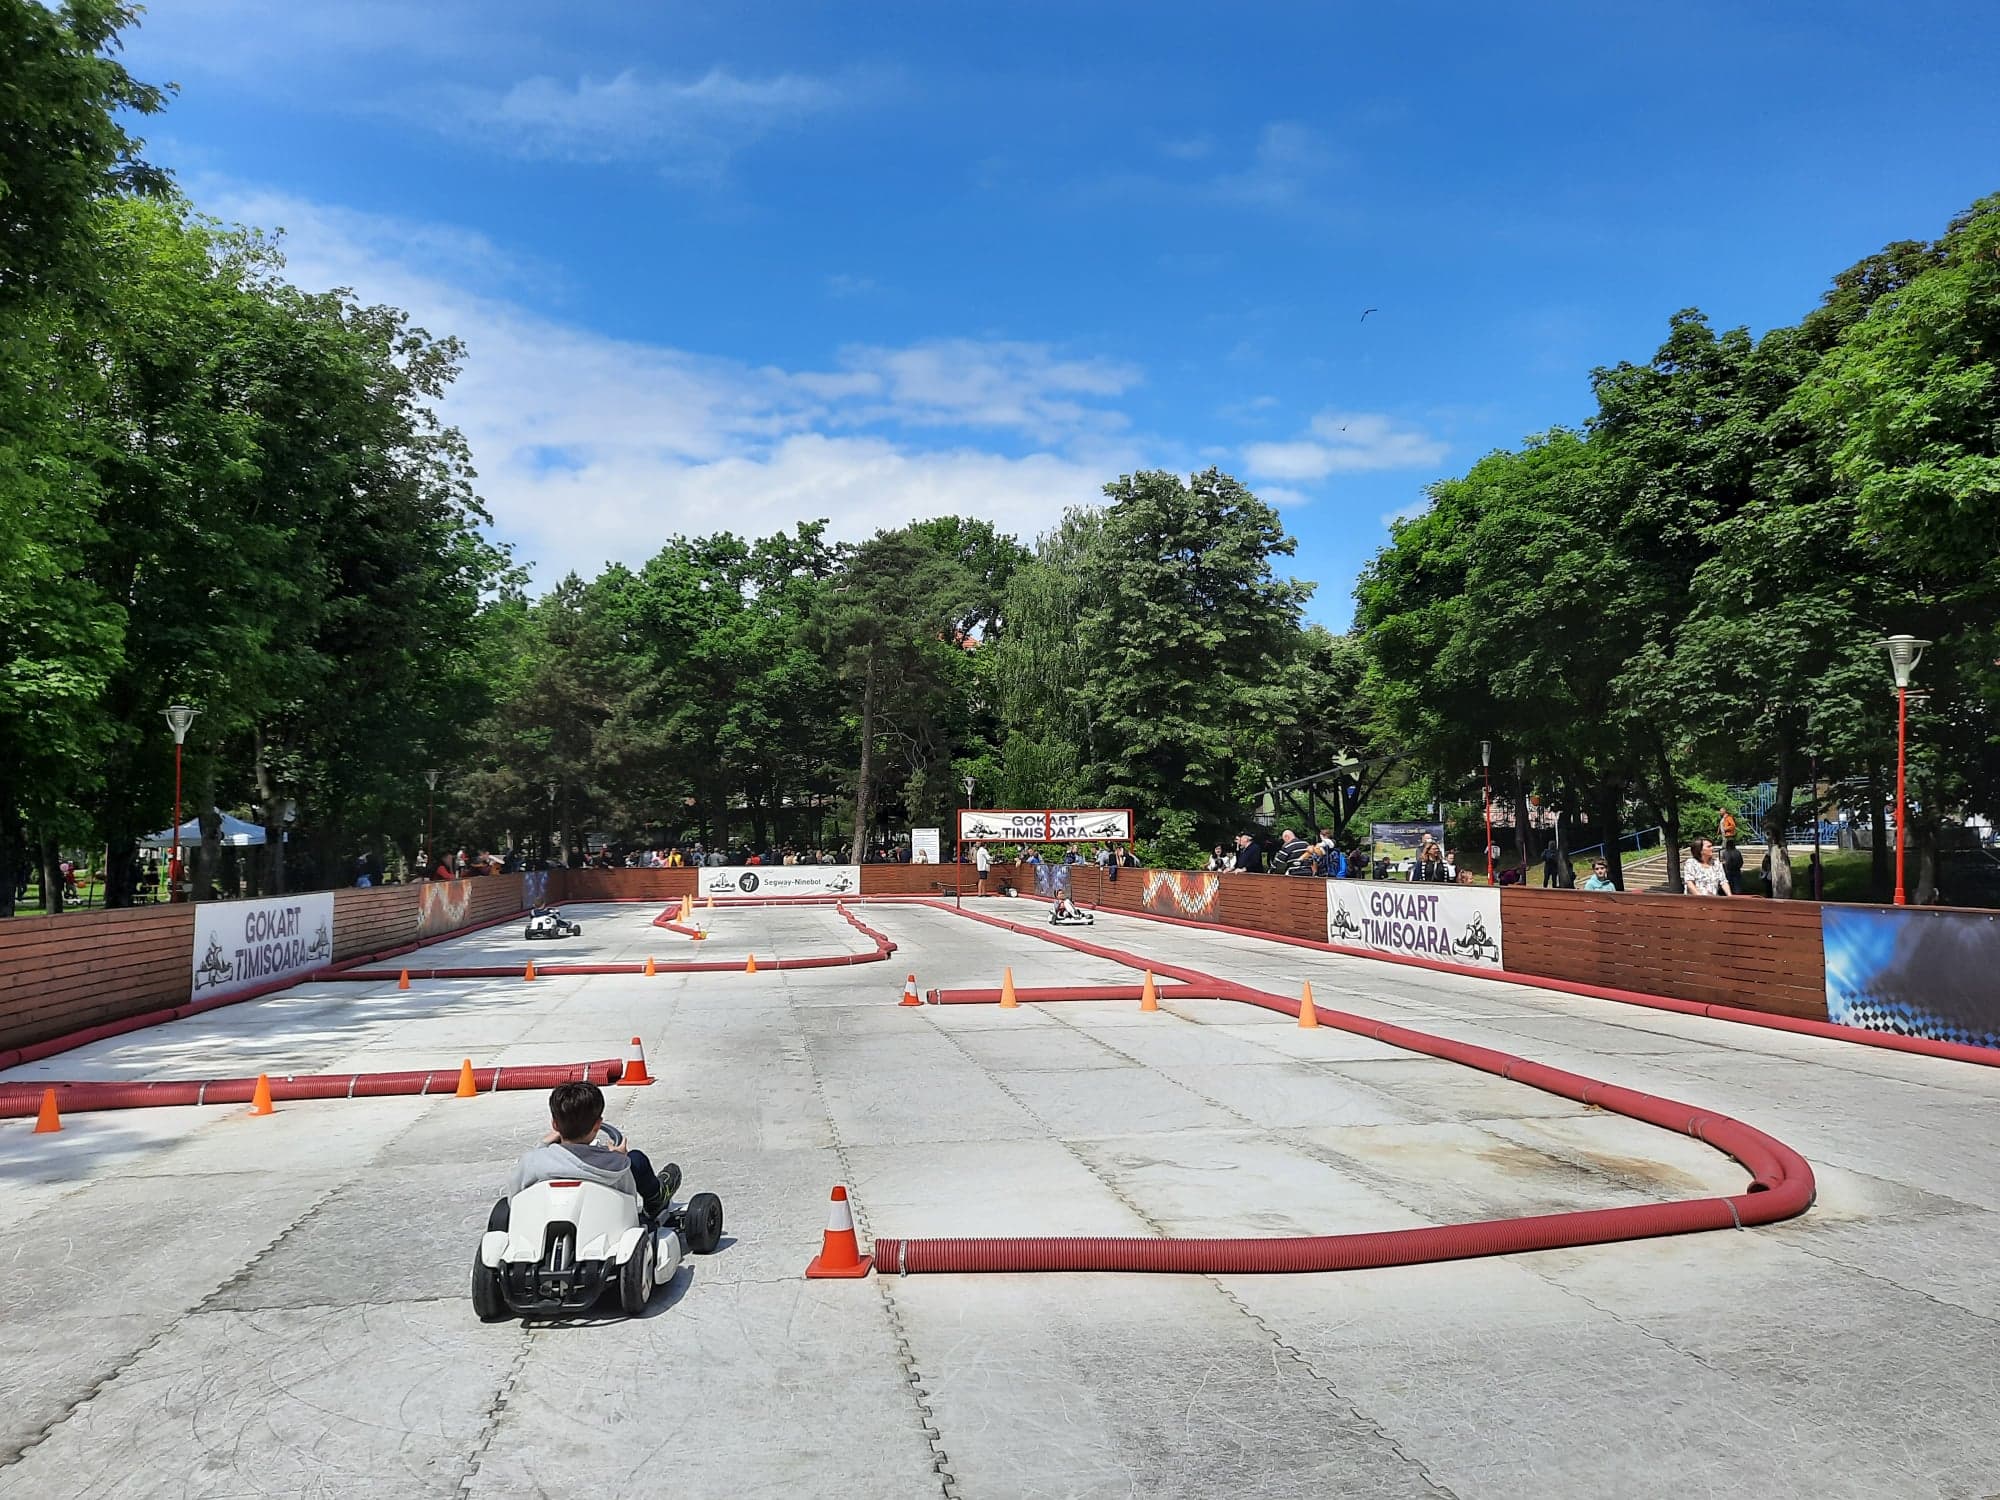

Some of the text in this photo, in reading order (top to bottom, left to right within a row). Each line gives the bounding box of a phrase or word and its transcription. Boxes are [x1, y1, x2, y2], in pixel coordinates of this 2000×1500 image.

[1002, 827, 1089, 838] TIMISOARA
[1011, 815, 1079, 826] GOKART
[764, 878, 821, 887] Segway-Ninebot
[1371, 891, 1439, 922] GOKART
[245, 906, 301, 943] GOKART
[1362, 918, 1452, 956] TIMISOARA
[235, 938, 306, 981] TIMISOARA
